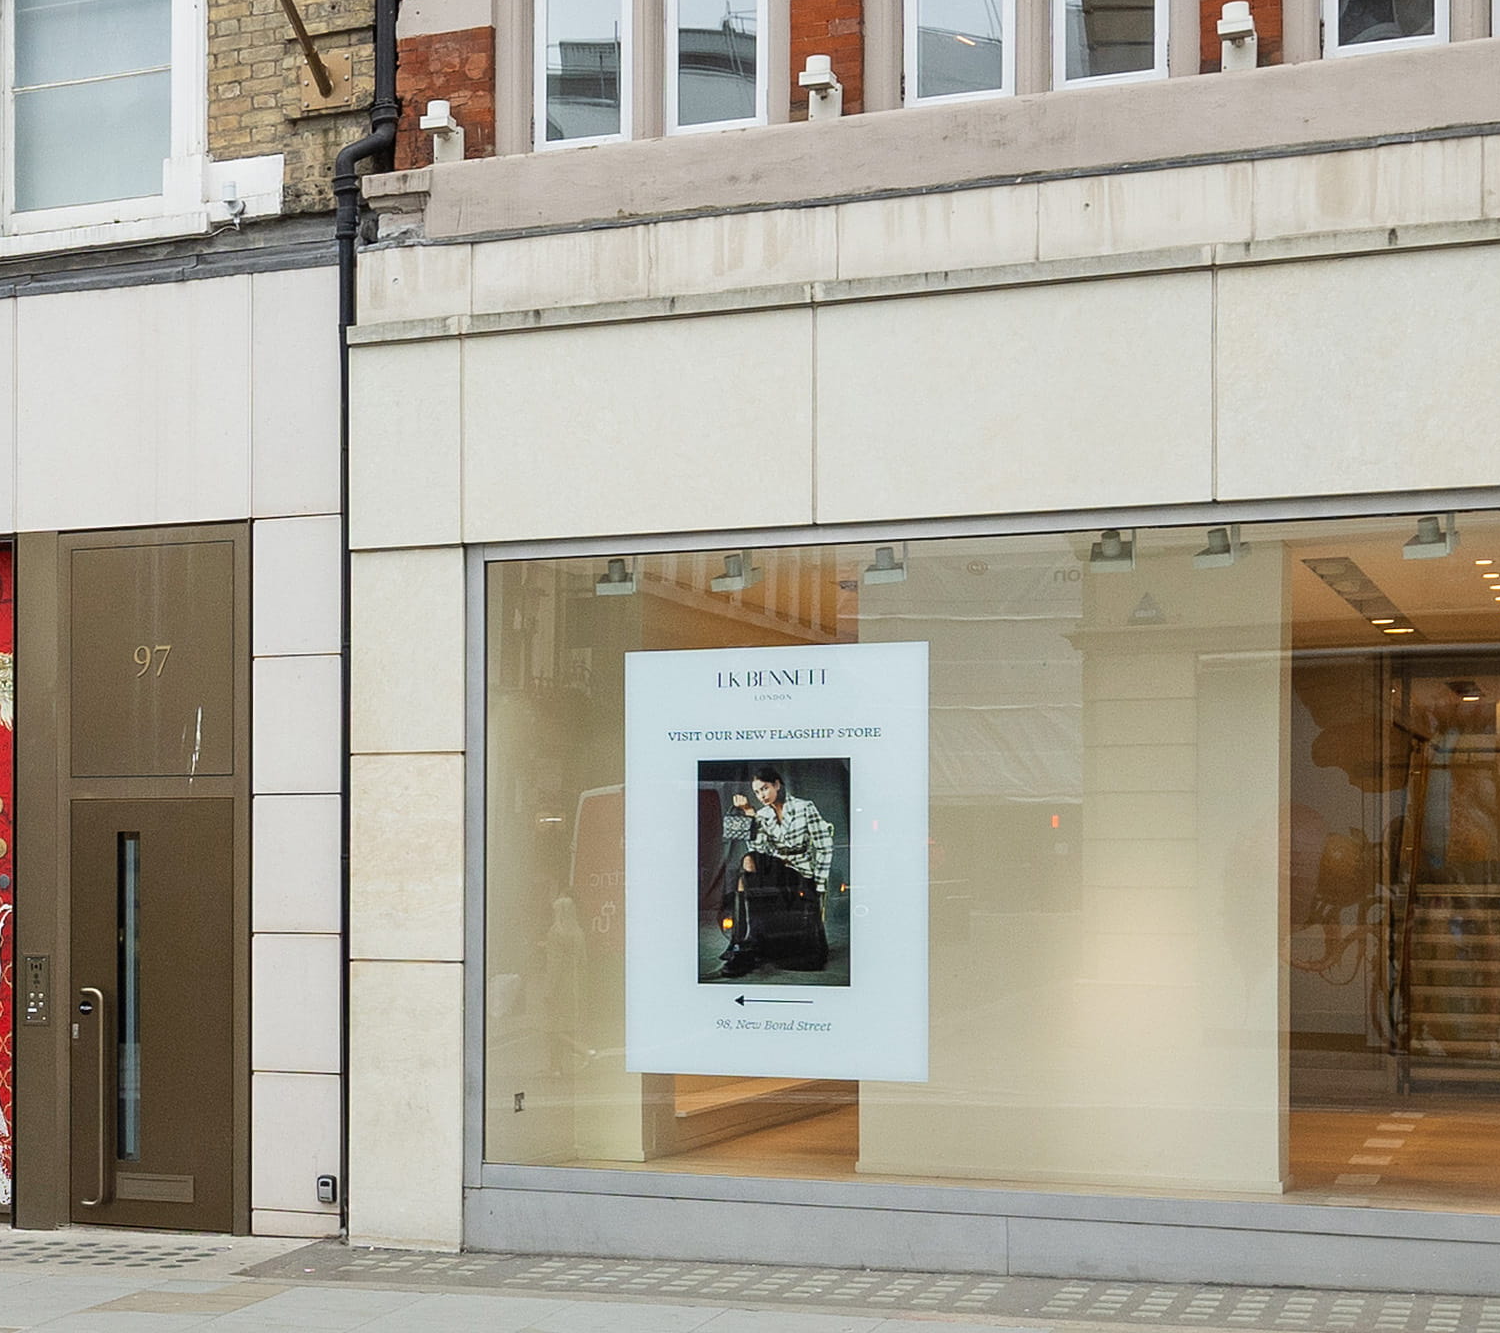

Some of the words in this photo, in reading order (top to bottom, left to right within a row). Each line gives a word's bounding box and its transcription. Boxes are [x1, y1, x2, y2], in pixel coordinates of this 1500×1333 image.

[133, 644, 172, 678] 97
[717, 670, 741, 689] LK
[746, 668, 829, 688] BENNETT
[667, 731, 703, 742] VISIT
[704, 730, 733, 742] OUR
[734, 729, 769, 741] NEW
[769, 727, 836, 740] FLAGSHIP
[837, 726, 882, 739] STORE
[715, 1018, 733, 1031] 98,
[735, 1019, 763, 1031] New
[764, 1019, 795, 1032] Bond
[796, 1020, 832, 1032] Street
